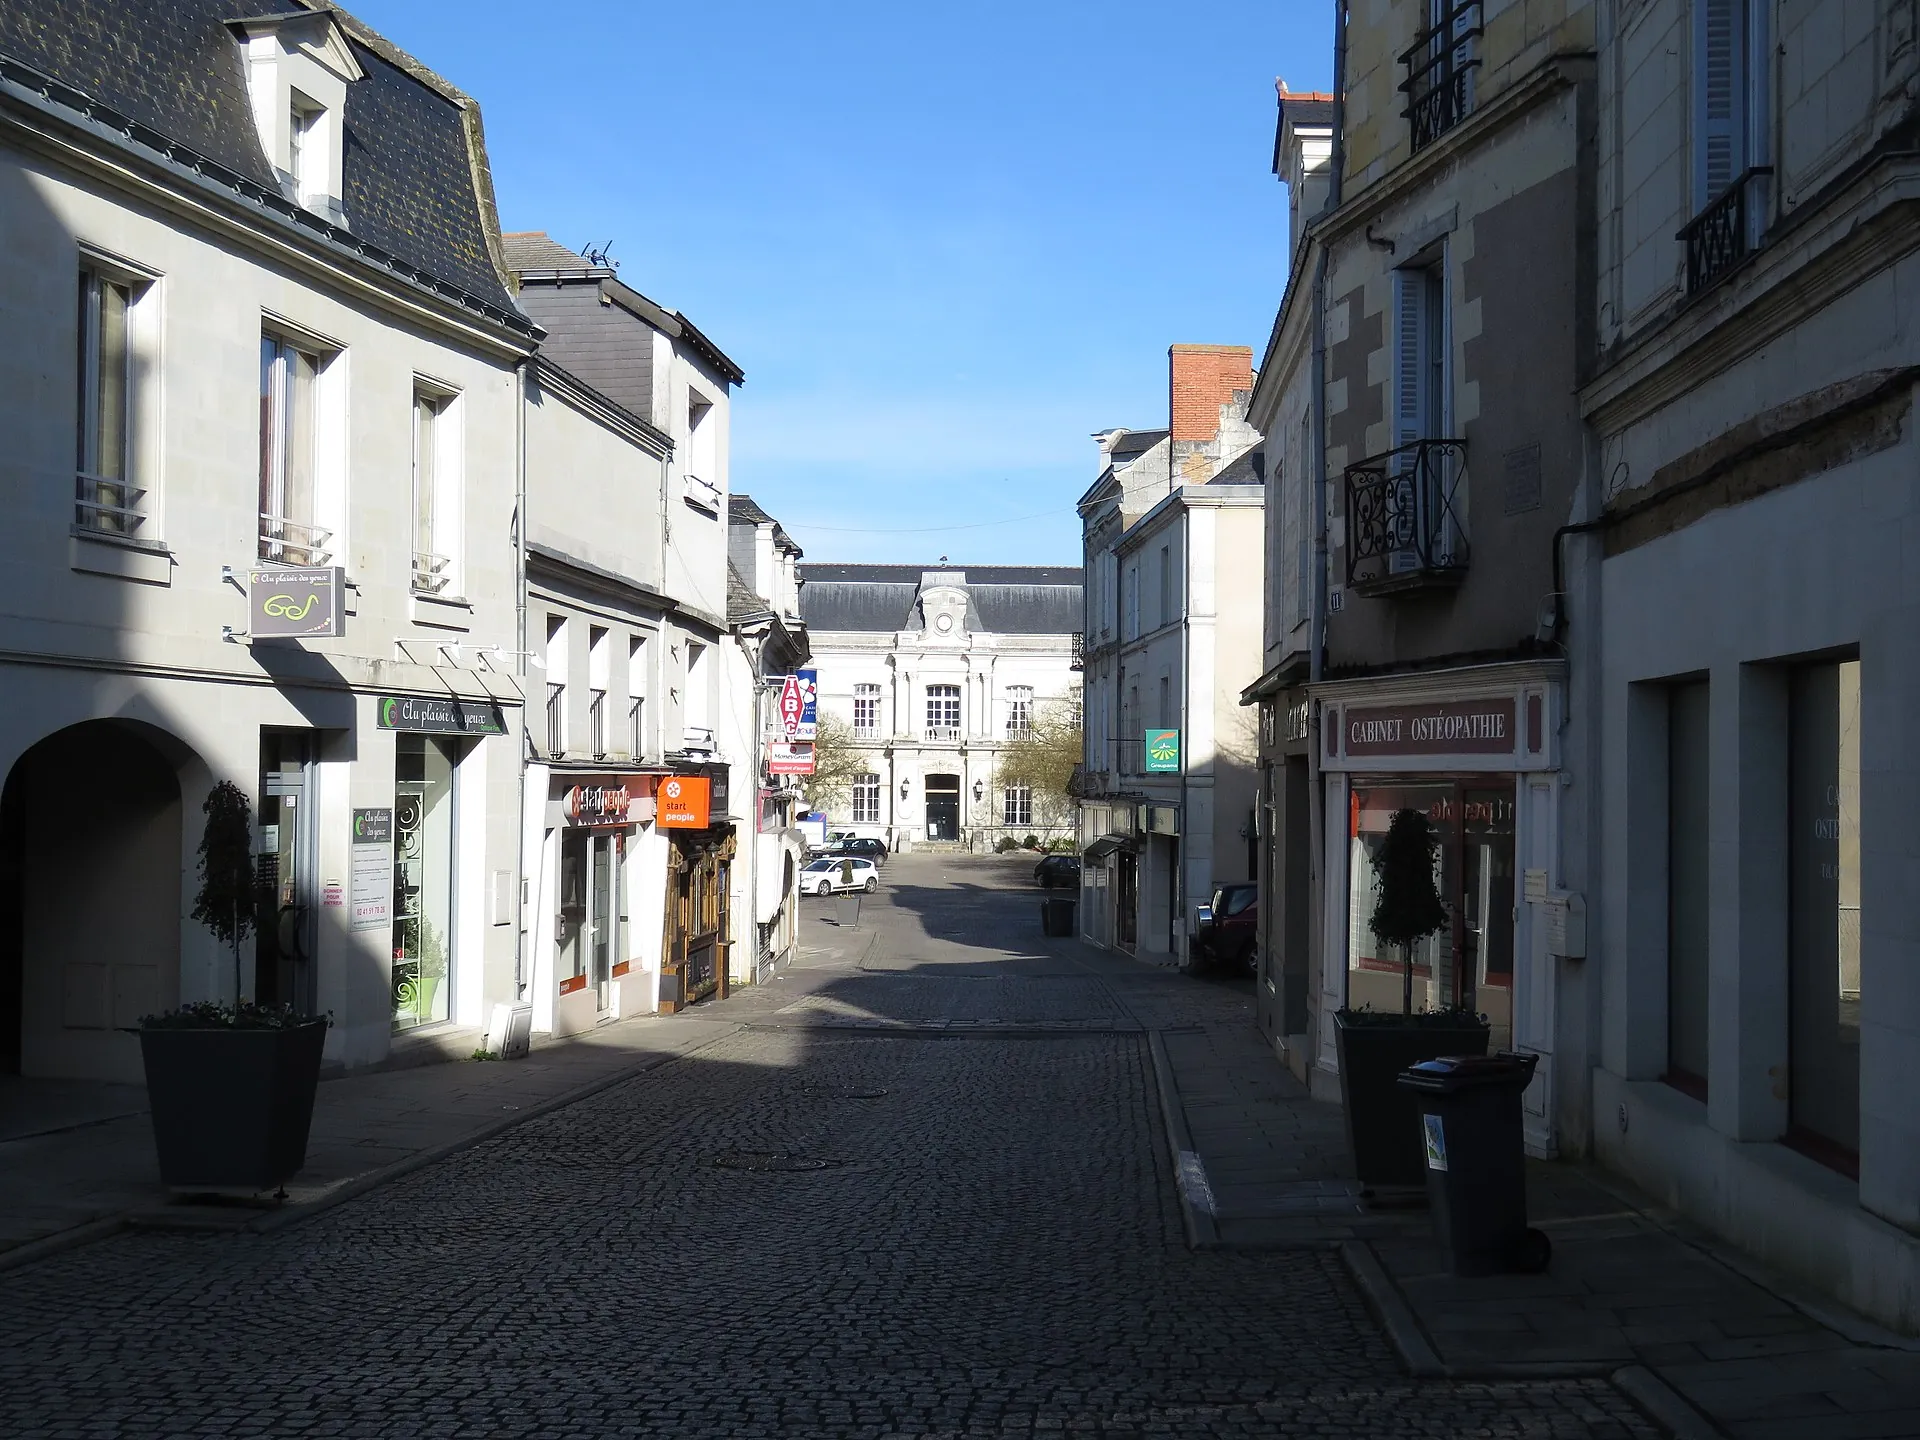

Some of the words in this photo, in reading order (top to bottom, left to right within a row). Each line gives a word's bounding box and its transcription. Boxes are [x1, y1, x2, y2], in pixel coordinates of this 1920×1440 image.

[261, 573, 275, 583] Au
[275, 573, 299, 585] plaisir
[299, 573, 309, 582] des
[309, 575, 328, 585] yeux
[402, 701, 420, 720] Au
[421, 703, 450, 728] plaisir
[464, 714, 486, 730] yeux
[784, 679, 798, 733] TABAC
[1351, 719, 1402, 743] CABINET
[1411, 710, 1505, 741] OSTÉOPATHIE
[580, 786, 602, 811] start
[600, 785, 630, 816] people
[666, 802, 686, 810] start
[665, 813, 695, 822] people
